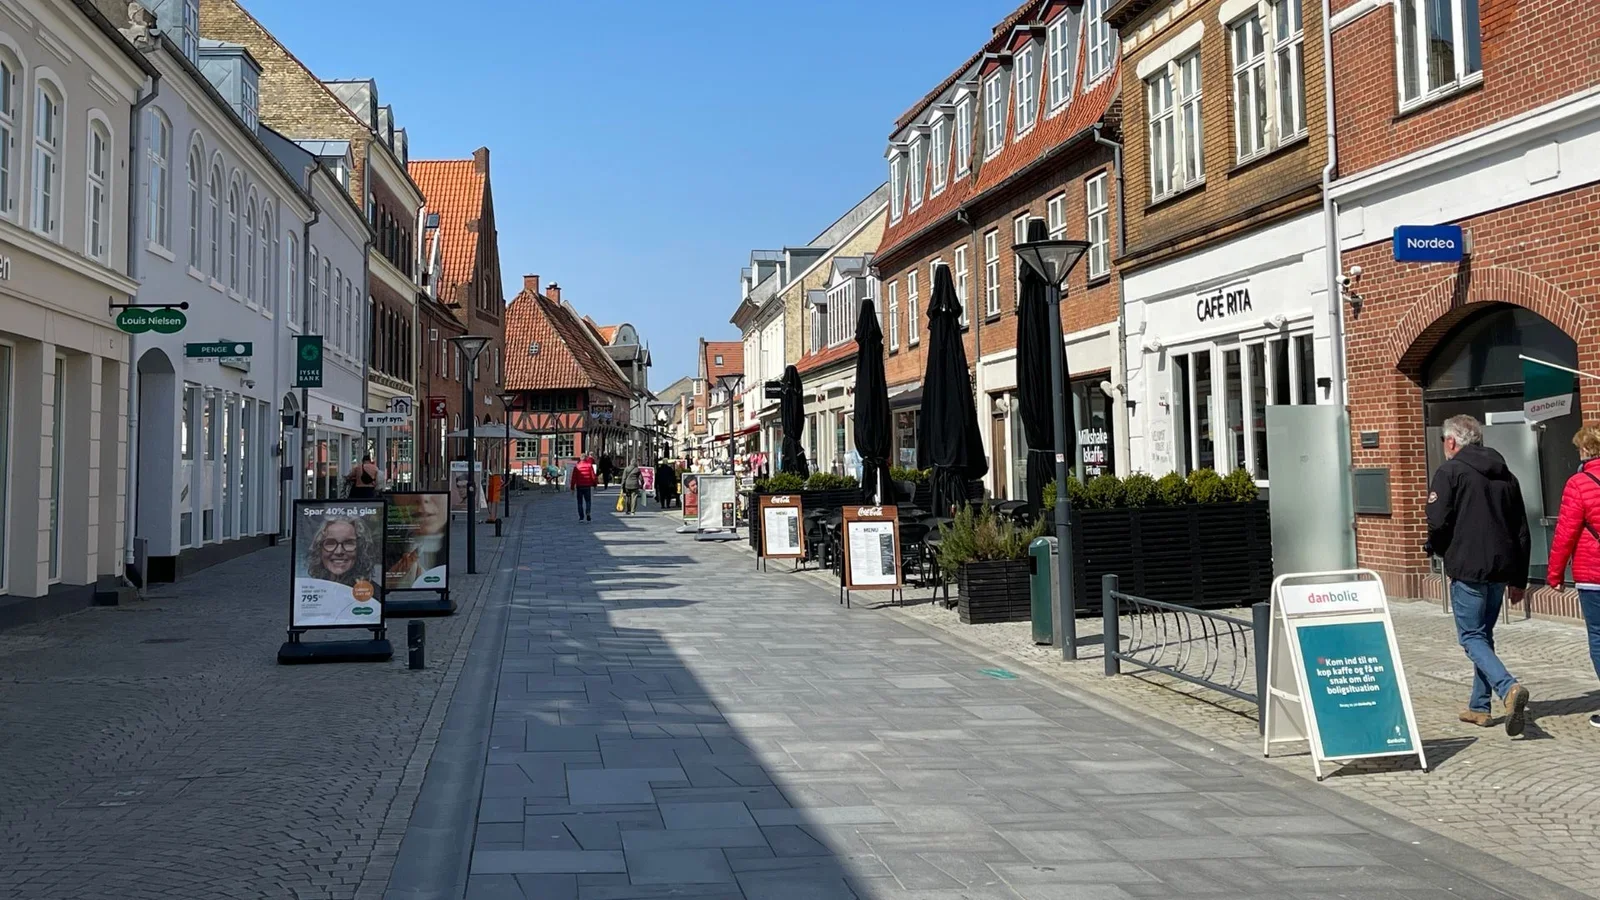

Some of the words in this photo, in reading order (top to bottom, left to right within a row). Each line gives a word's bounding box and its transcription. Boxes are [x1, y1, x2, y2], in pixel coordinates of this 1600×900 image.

[1407, 237, 1455, 249] Nordea
[1196, 288, 1225, 322] CAFÉ
[1226, 288, 1253, 316] RITA
[121, 316, 146, 326] Louis
[147, 316, 182, 326] Nielsen
[201, 346, 228, 354] PENGE
[1530, 400, 1566, 413] danbolig
[1078, 427, 1108, 445] Milkshake
[1083, 445, 1104, 463] Iskaffe
[303, 507, 325, 517] Spar
[325, 507, 346, 516] 40%
[346, 506, 358, 517] på
[359, 507, 377, 517] glas
[301, 594, 319, 603] 795
[1308, 590, 1360, 604] danbolig
[1325, 658, 1344, 666] Kom
[1344, 656, 1358, 665] ind
[1358, 656, 1367, 664] til
[1367, 656, 1379, 664] en
[1316, 668, 1332, 678] kop
[1332, 666, 1353, 676] kaffe
[1353, 667, 1364, 676] og
[1364, 665, 1374, 673] få
[1374, 665, 1385, 673] en
[1329, 676, 1349, 685] snak
[1349, 676, 1362, 684] om
[1362, 674, 1376, 683] din
[1326, 684, 1380, 696] boligsituation
